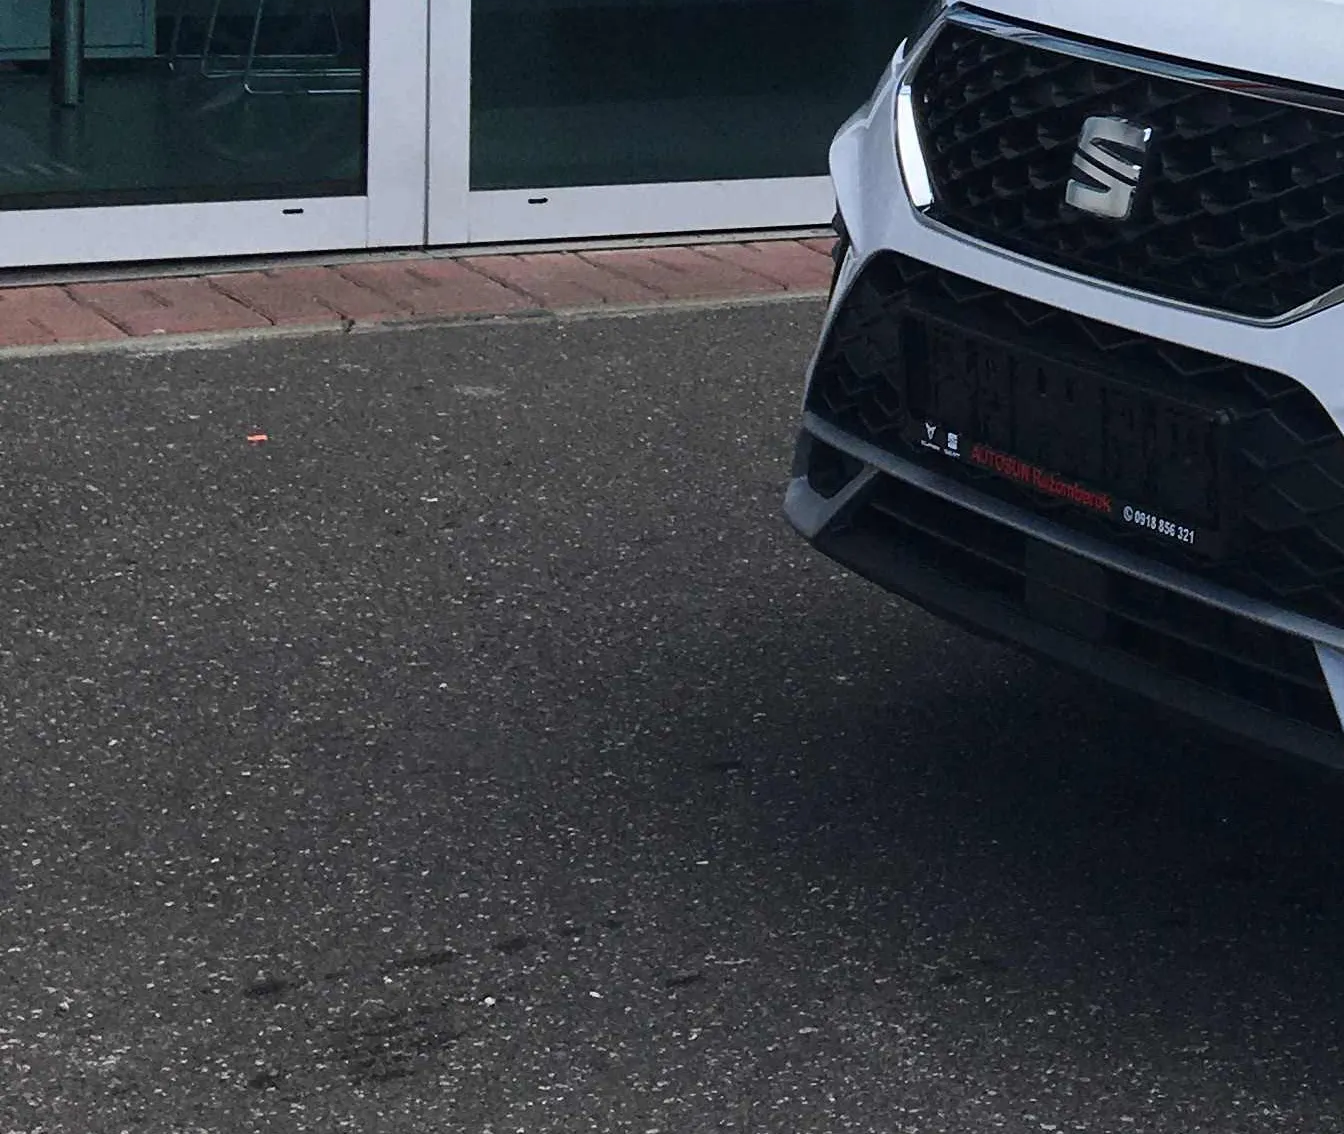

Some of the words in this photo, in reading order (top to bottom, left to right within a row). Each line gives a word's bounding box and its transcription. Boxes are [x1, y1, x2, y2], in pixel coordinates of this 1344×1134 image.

[970, 445, 1031, 483] AUTOSUN
[1134, 510, 1157, 530] 0918
[1177, 526, 1195, 544] 321
